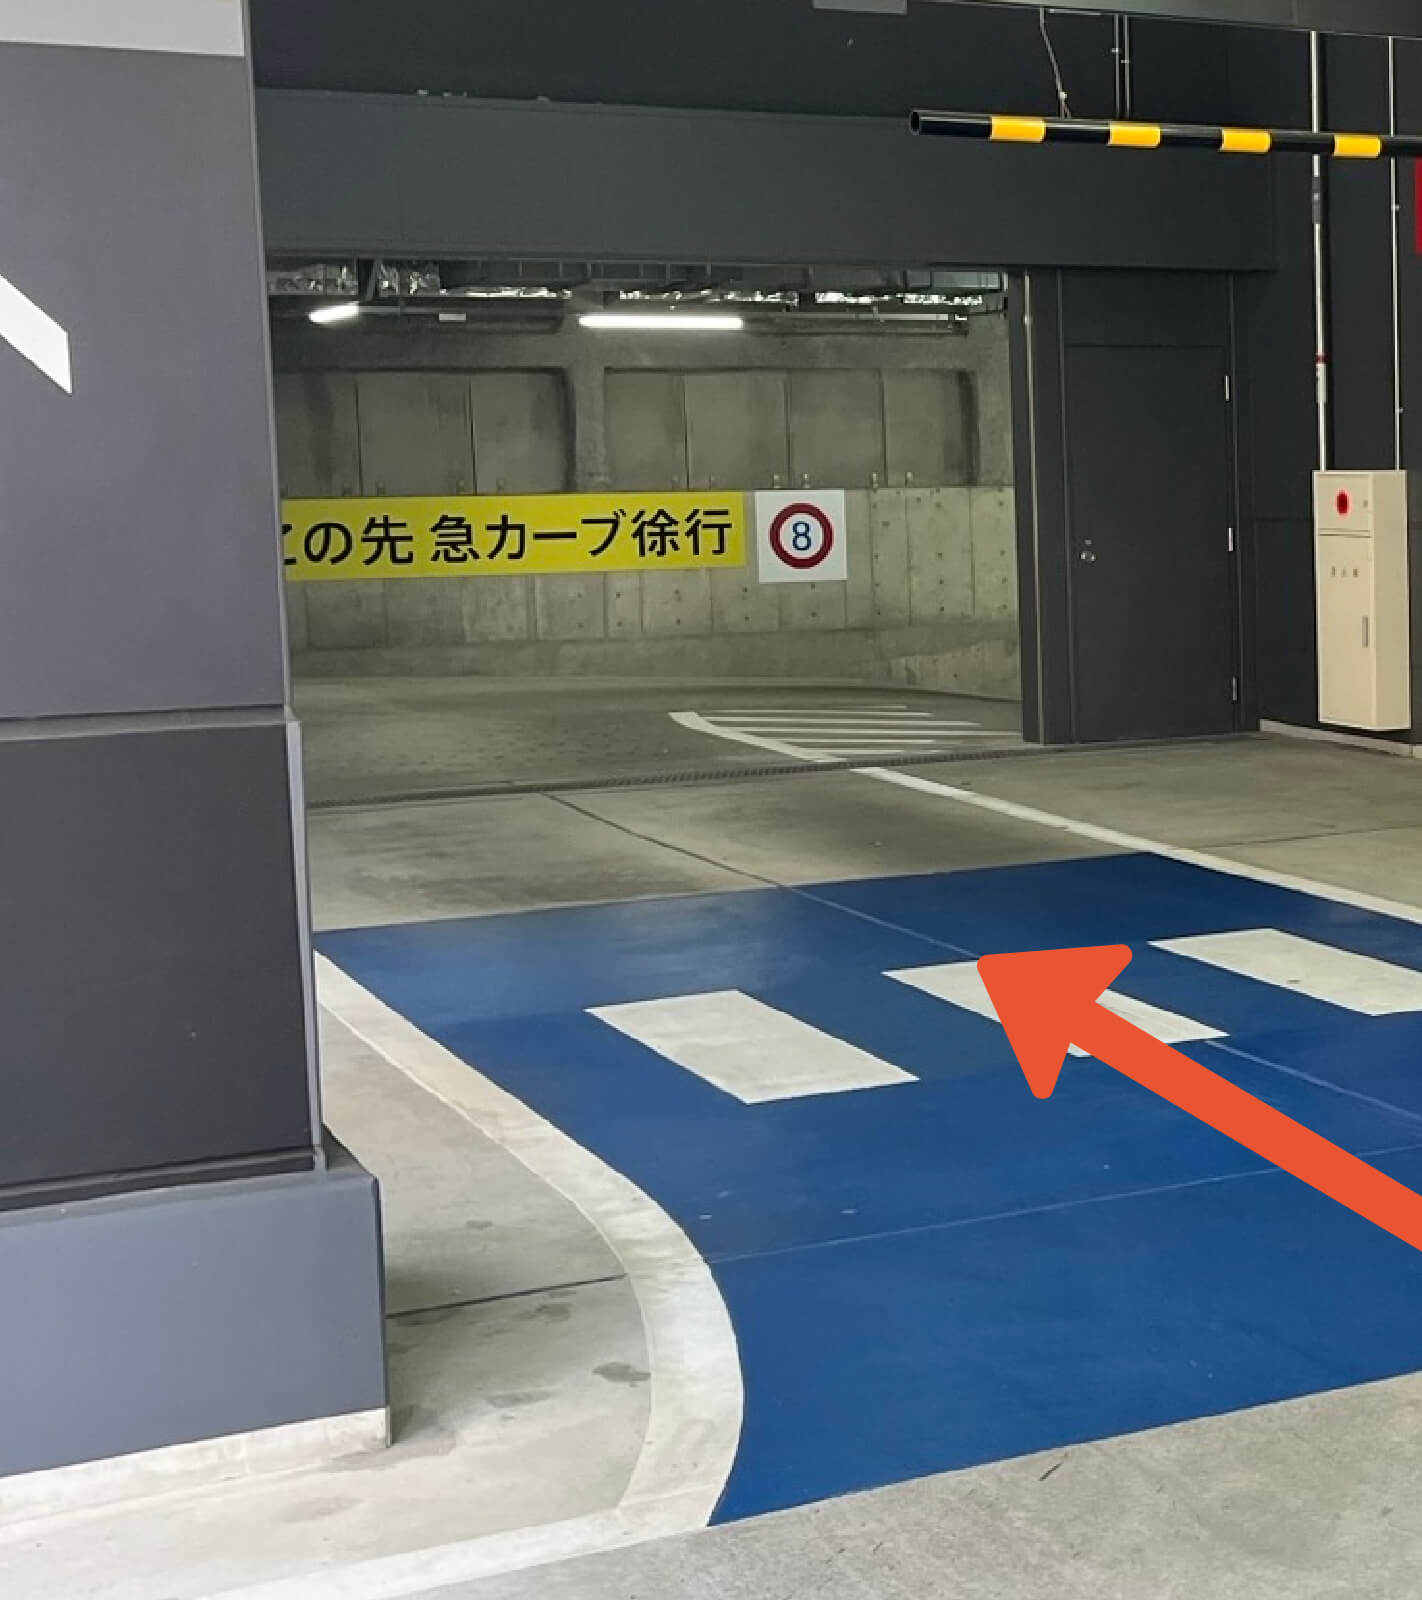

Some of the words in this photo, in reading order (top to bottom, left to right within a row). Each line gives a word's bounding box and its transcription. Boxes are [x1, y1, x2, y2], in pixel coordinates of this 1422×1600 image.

[429, 507, 733, 563] 急カーブ徐行
[791, 520, 813, 552] 8
